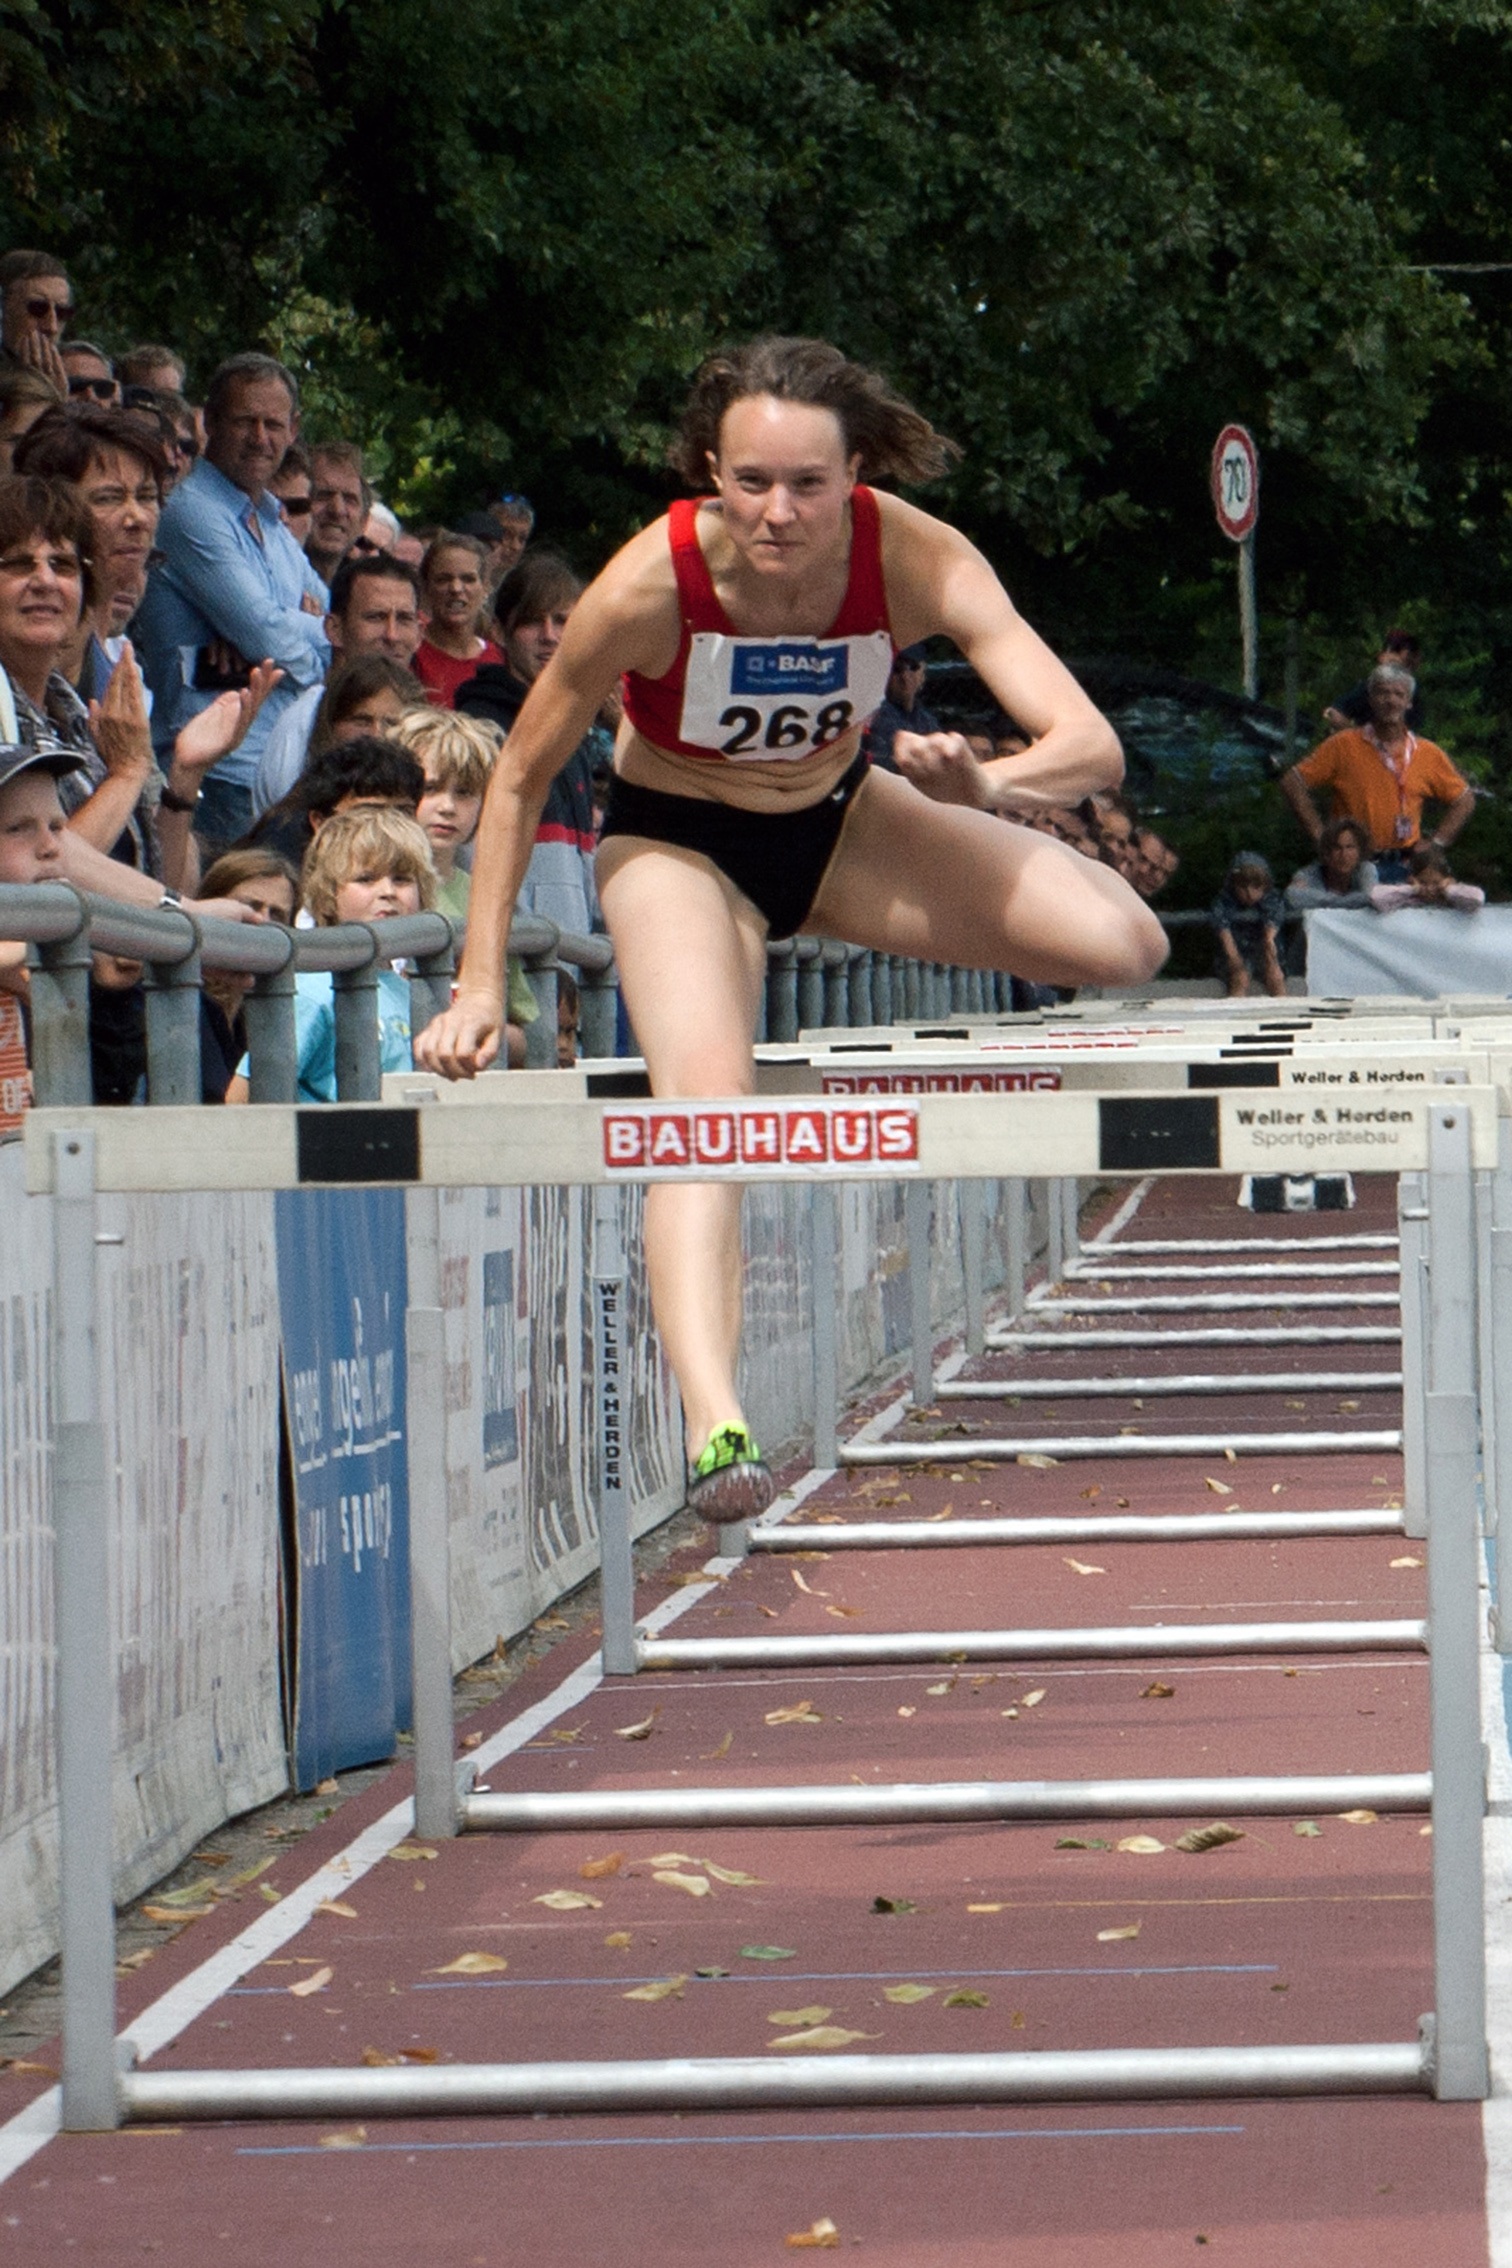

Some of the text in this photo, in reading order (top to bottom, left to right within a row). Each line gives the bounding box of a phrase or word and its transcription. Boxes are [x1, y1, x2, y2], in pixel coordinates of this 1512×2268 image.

[1224, 457, 1247, 502] 70
[719, 700, 855, 755] 268
[1291, 1070, 1425, 1083] Weller & Herden
[1237, 1107, 1413, 1124] Weller & Herden
[608, 1116, 913, 1158] BAUHAUS
[1251, 1130, 1400, 1149] Sportgerätebau
[600, 1282, 620, 1489] WELLER & HERDEN
